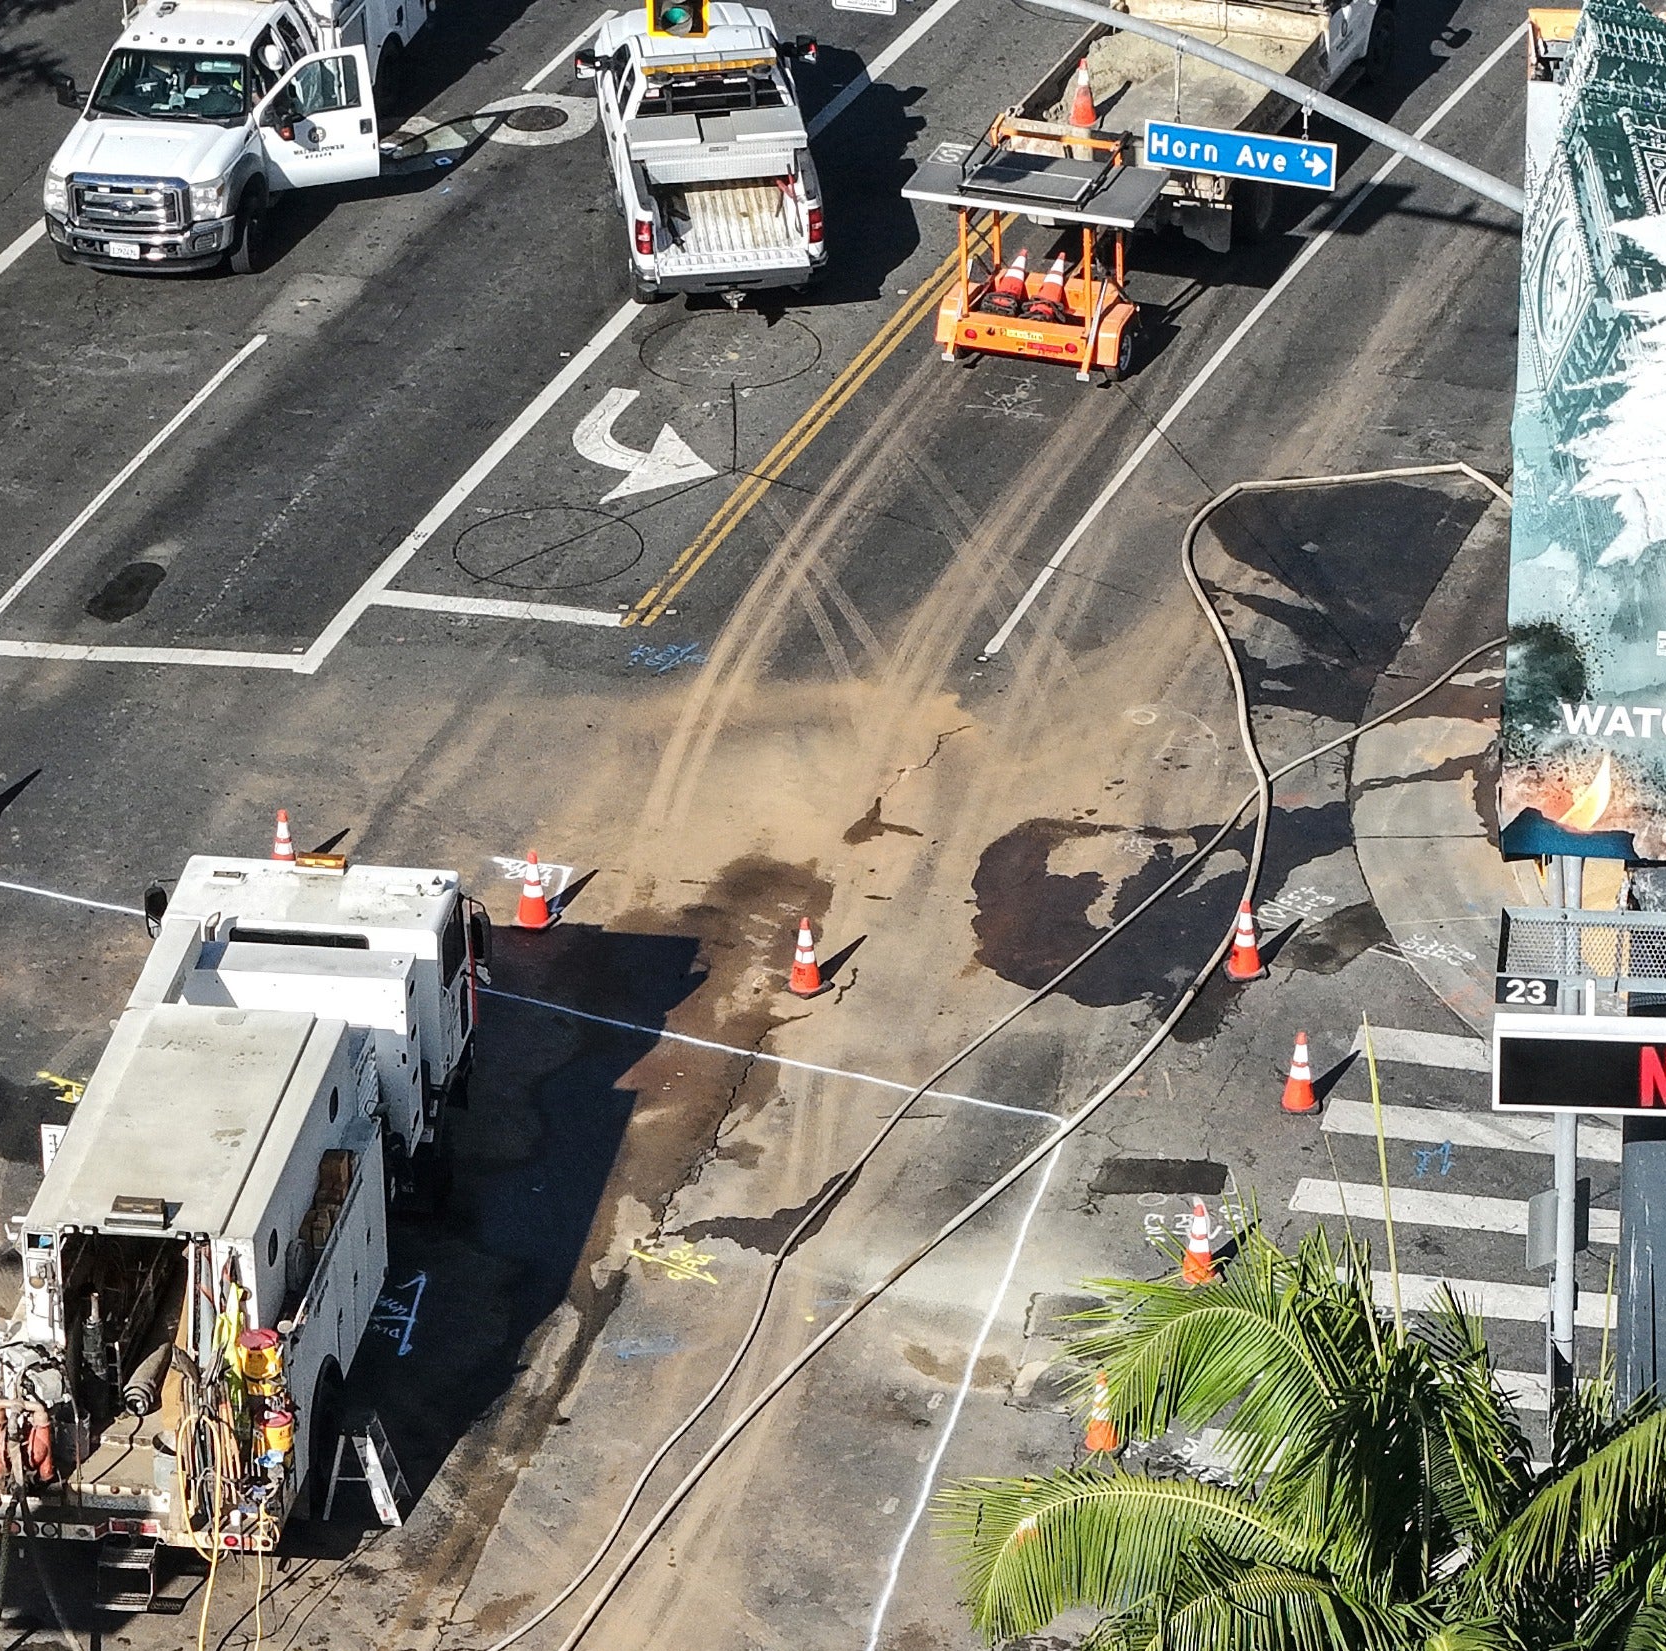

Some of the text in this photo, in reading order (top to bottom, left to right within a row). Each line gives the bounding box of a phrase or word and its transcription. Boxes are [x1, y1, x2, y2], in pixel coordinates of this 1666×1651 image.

[1150, 131, 1288, 173] Horn Ave
[1505, 978, 1548, 1005] 23
